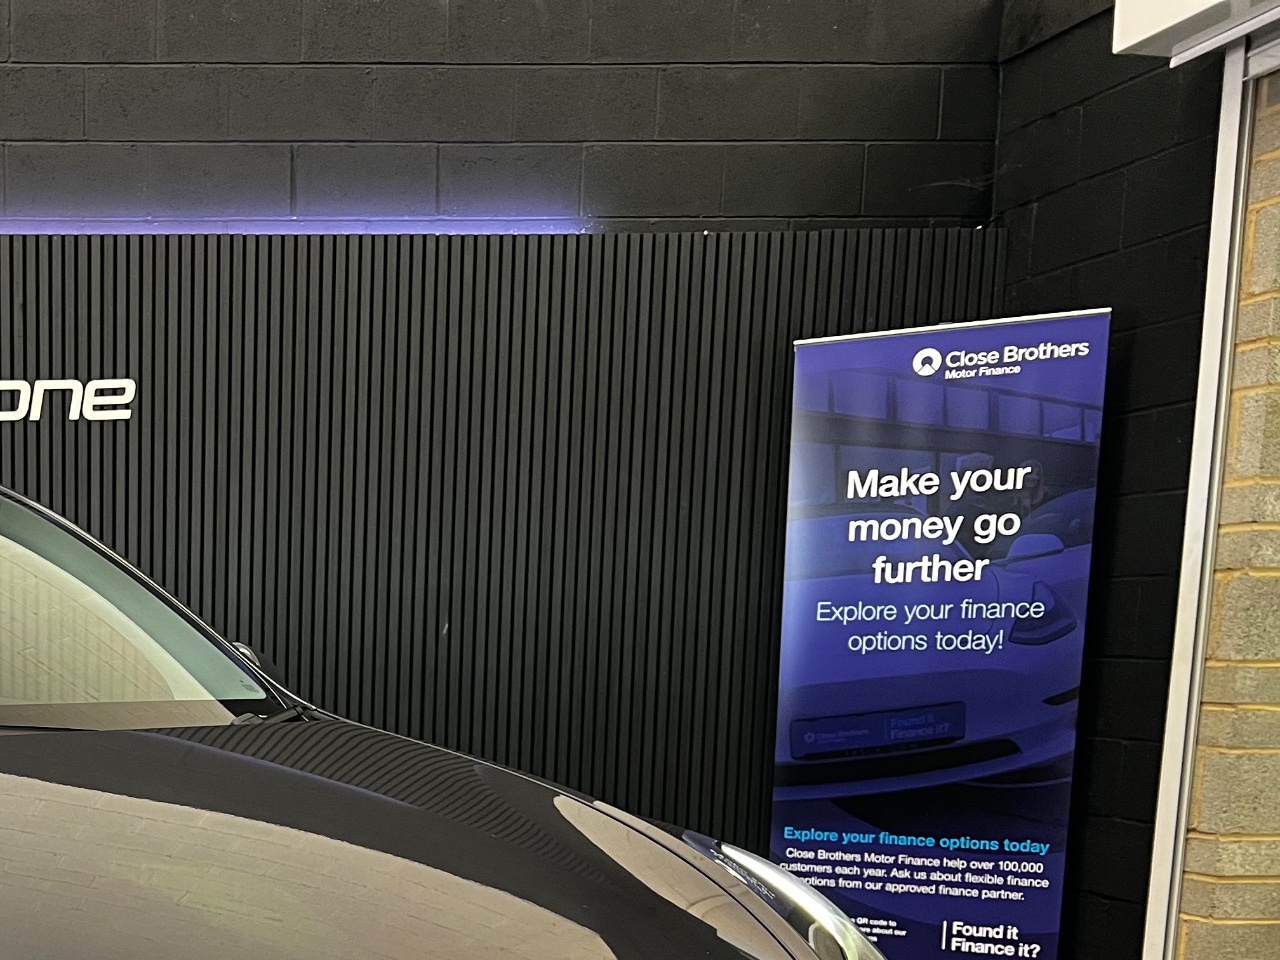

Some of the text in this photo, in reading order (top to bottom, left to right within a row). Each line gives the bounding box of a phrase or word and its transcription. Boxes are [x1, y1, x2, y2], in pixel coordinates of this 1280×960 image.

[946, 342, 1090, 368] Close Brothers
[945, 365, 1021, 380] Motor Finance
[847, 466, 1032, 500] Make your
[848, 513, 1021, 545] money go
[872, 554, 990, 584] further
[816, 598, 1045, 626] Explore your finance
[848, 630, 1004, 654] options today!
[783, 826, 1050, 855] Explore your finance options today
[785, 847, 1044, 873] Close Brothers Motor Finance help over 100,000
[780, 862, 1050, 888] customers each year. Ask us about flexible finance
[838, 877, 862, 889] from
[864, 881, 883, 890] our
[885, 882, 935, 894] approved
[938, 884, 979, 897] finance
[981, 888, 1025, 901] partner.
[856, 916, 868, 925] QR
[888, 919, 897, 927] to
[952, 921, 1019, 940] Found it
[951, 937, 1041, 958] Finance it?
